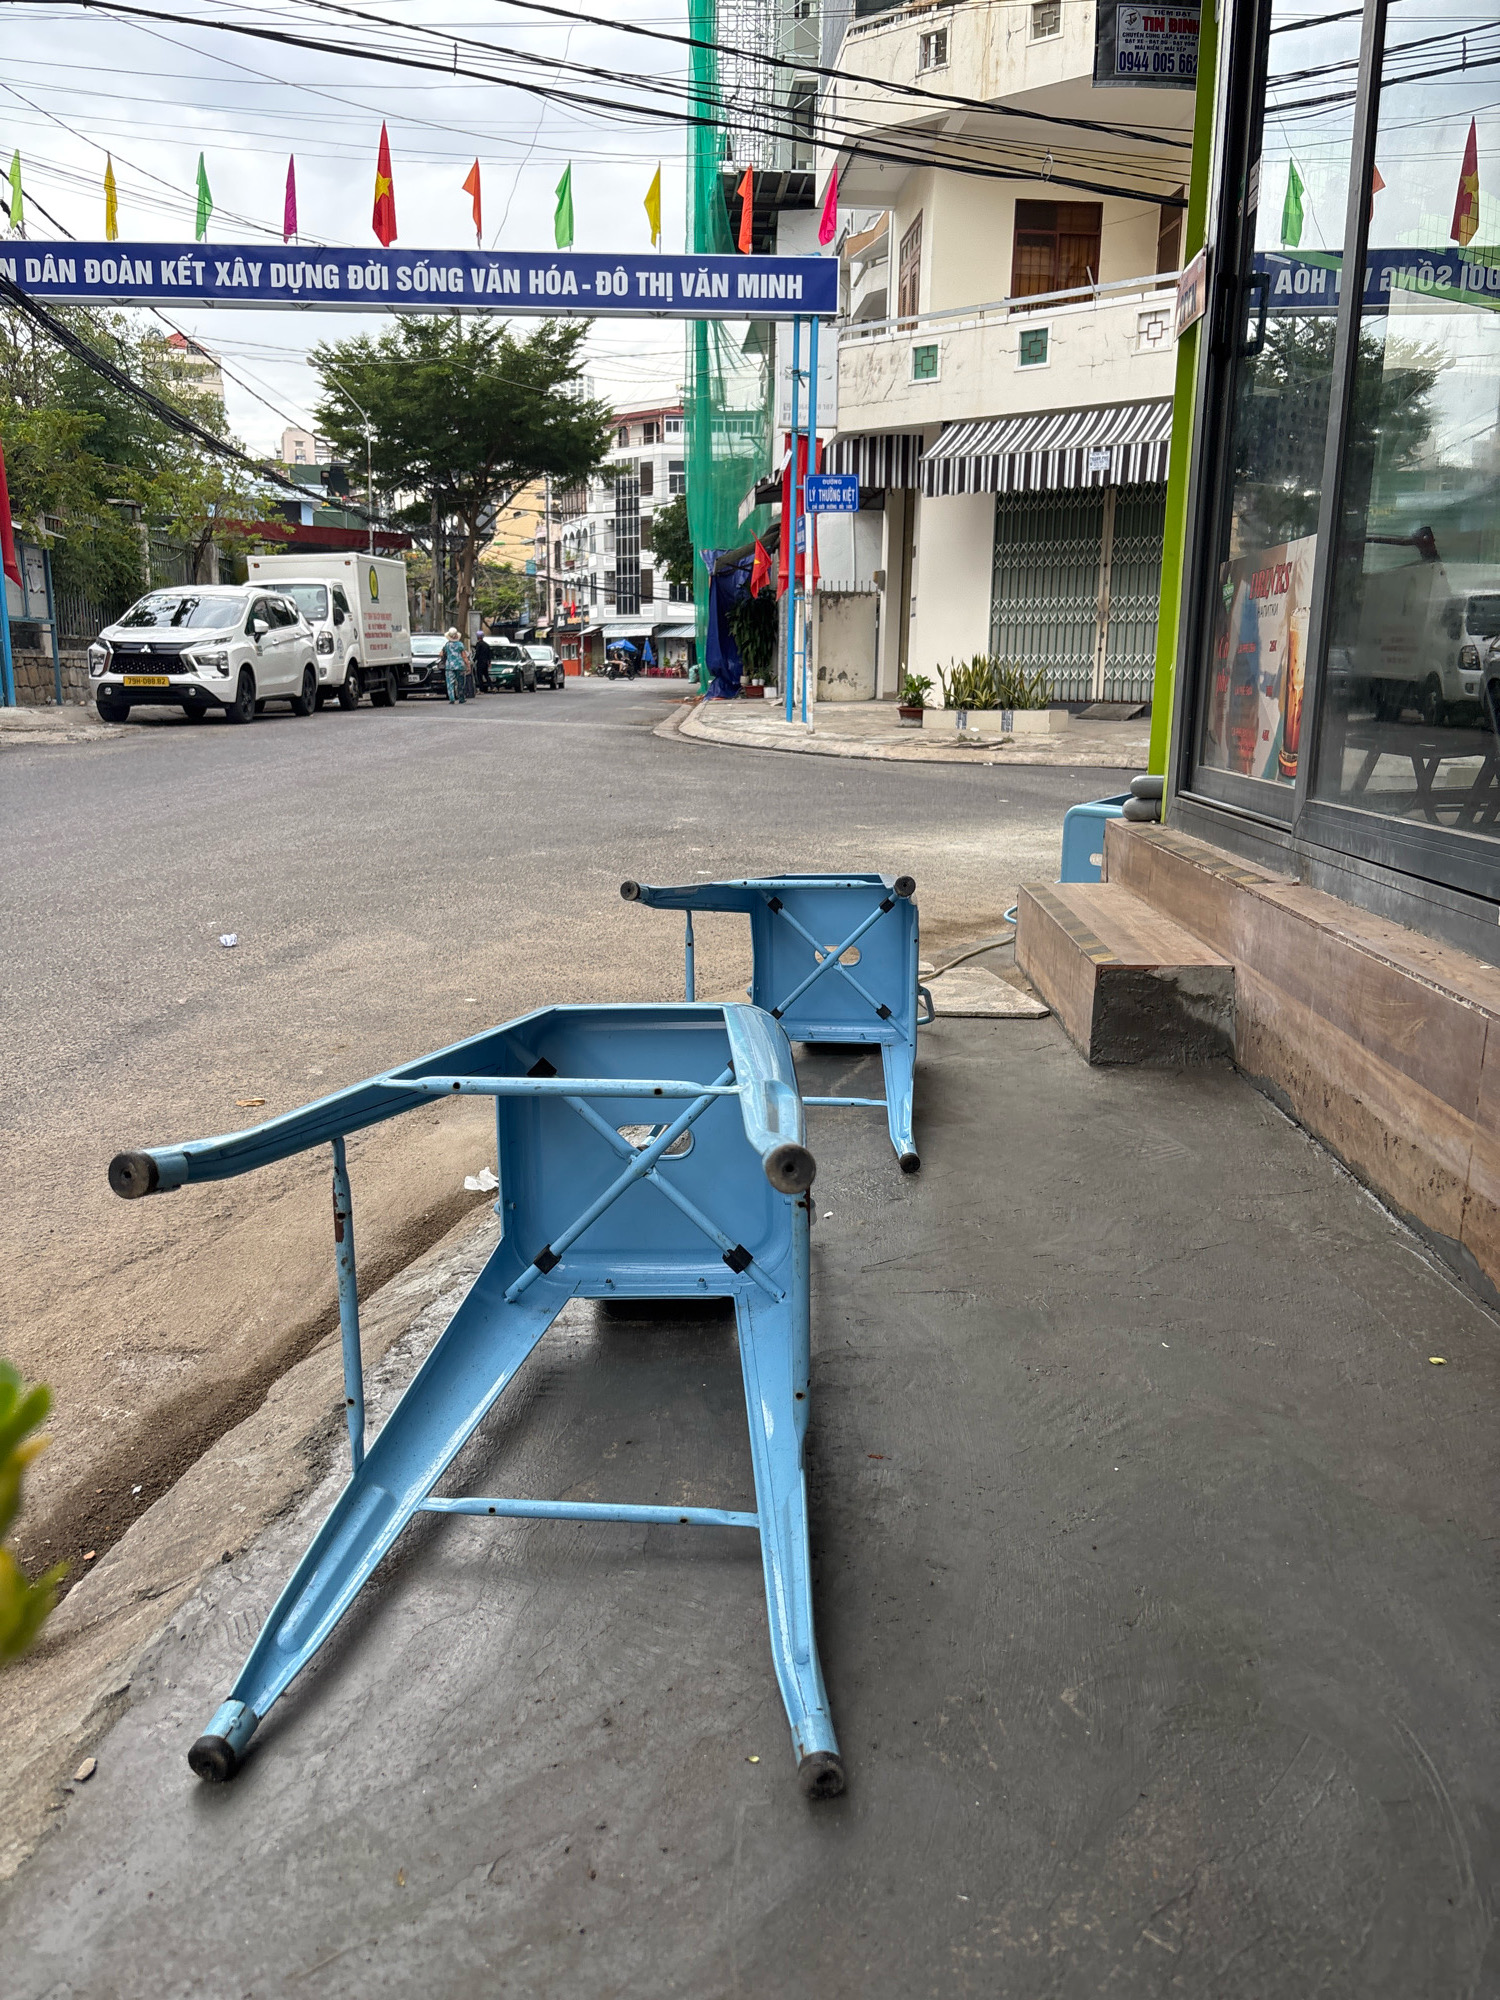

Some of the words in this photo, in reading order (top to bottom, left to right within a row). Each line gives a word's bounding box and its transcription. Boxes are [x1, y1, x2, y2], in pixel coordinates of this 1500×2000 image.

[1119, 51, 1149, 72] 0944
[1153, 52, 1175, 73] 005
[25, 254, 77, 283] DÂN
[84, 254, 153, 286] ĐOÀN
[161, 253, 206, 286] KẾT
[214, 257, 263, 288] XÂY
[270, 262, 340, 294] DỰNG
[346, 260, 389, 291] ĐỜI
[396, 260, 464, 292] SỐNG
[470, 263, 521, 294] VĂN
[635, 271, 674, 302] THỊ
[680, 268, 729, 298] VĂN
[737, 273, 803, 300] MINH
[808, 486, 817, 502] LÝ
[818, 485, 841, 502] THƯỜNG
[842, 486, 856, 504] KIỆT
